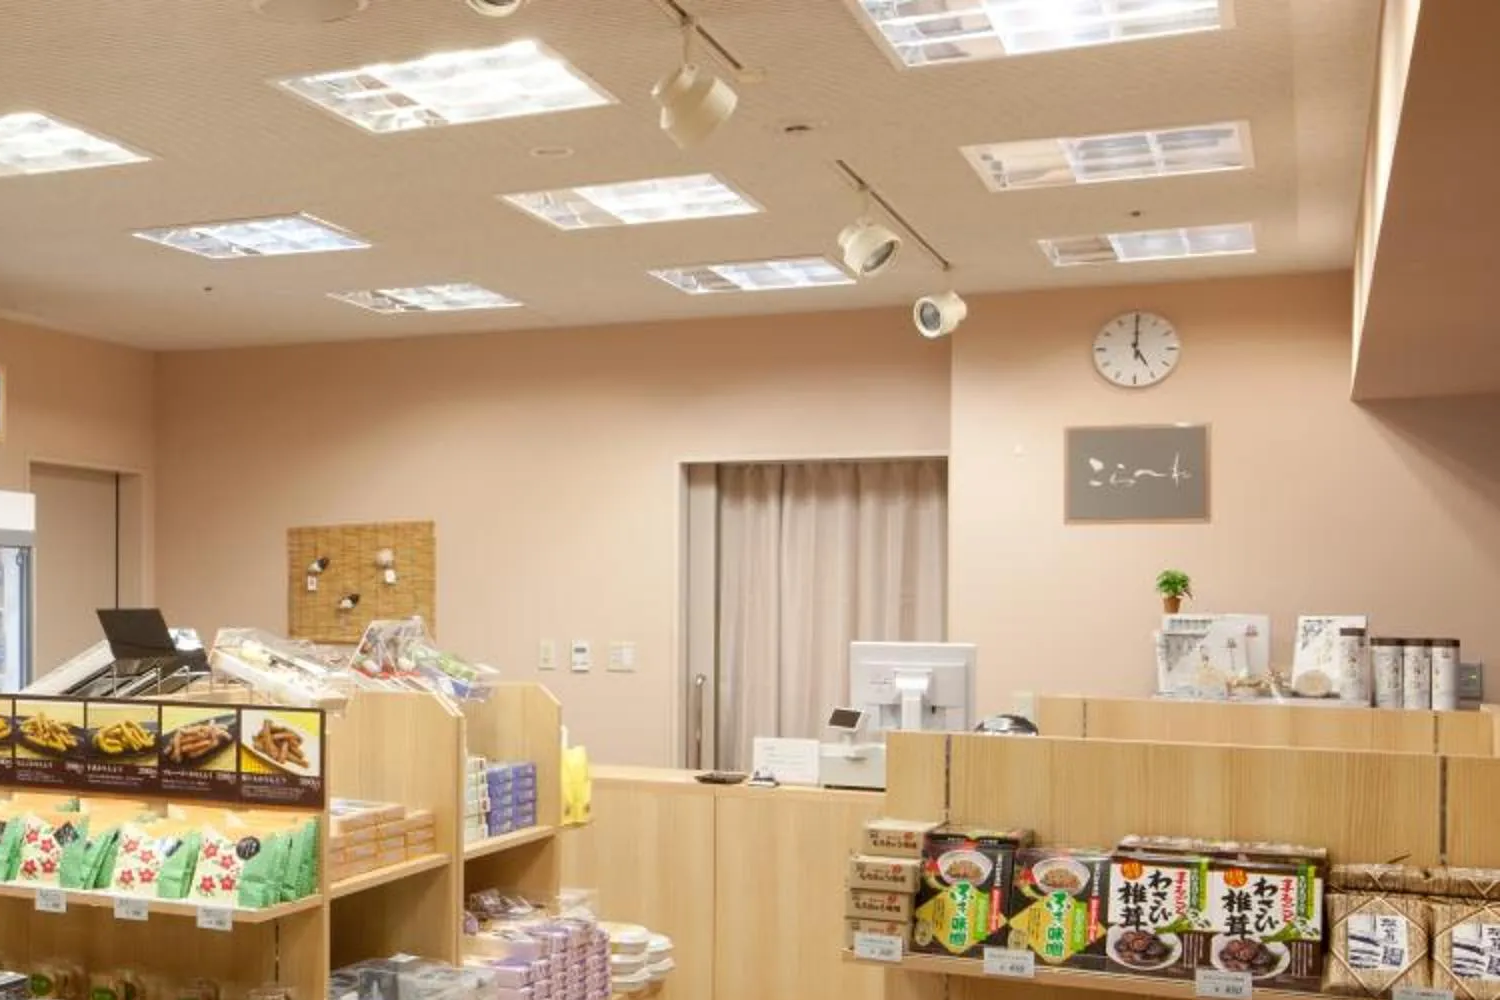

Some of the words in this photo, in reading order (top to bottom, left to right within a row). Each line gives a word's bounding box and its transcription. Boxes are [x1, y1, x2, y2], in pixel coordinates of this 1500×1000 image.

[1118, 881, 1147, 932] 椎茸
[1221, 888, 1253, 941] 椎茸
[1252, 876, 1280, 933] わさび
